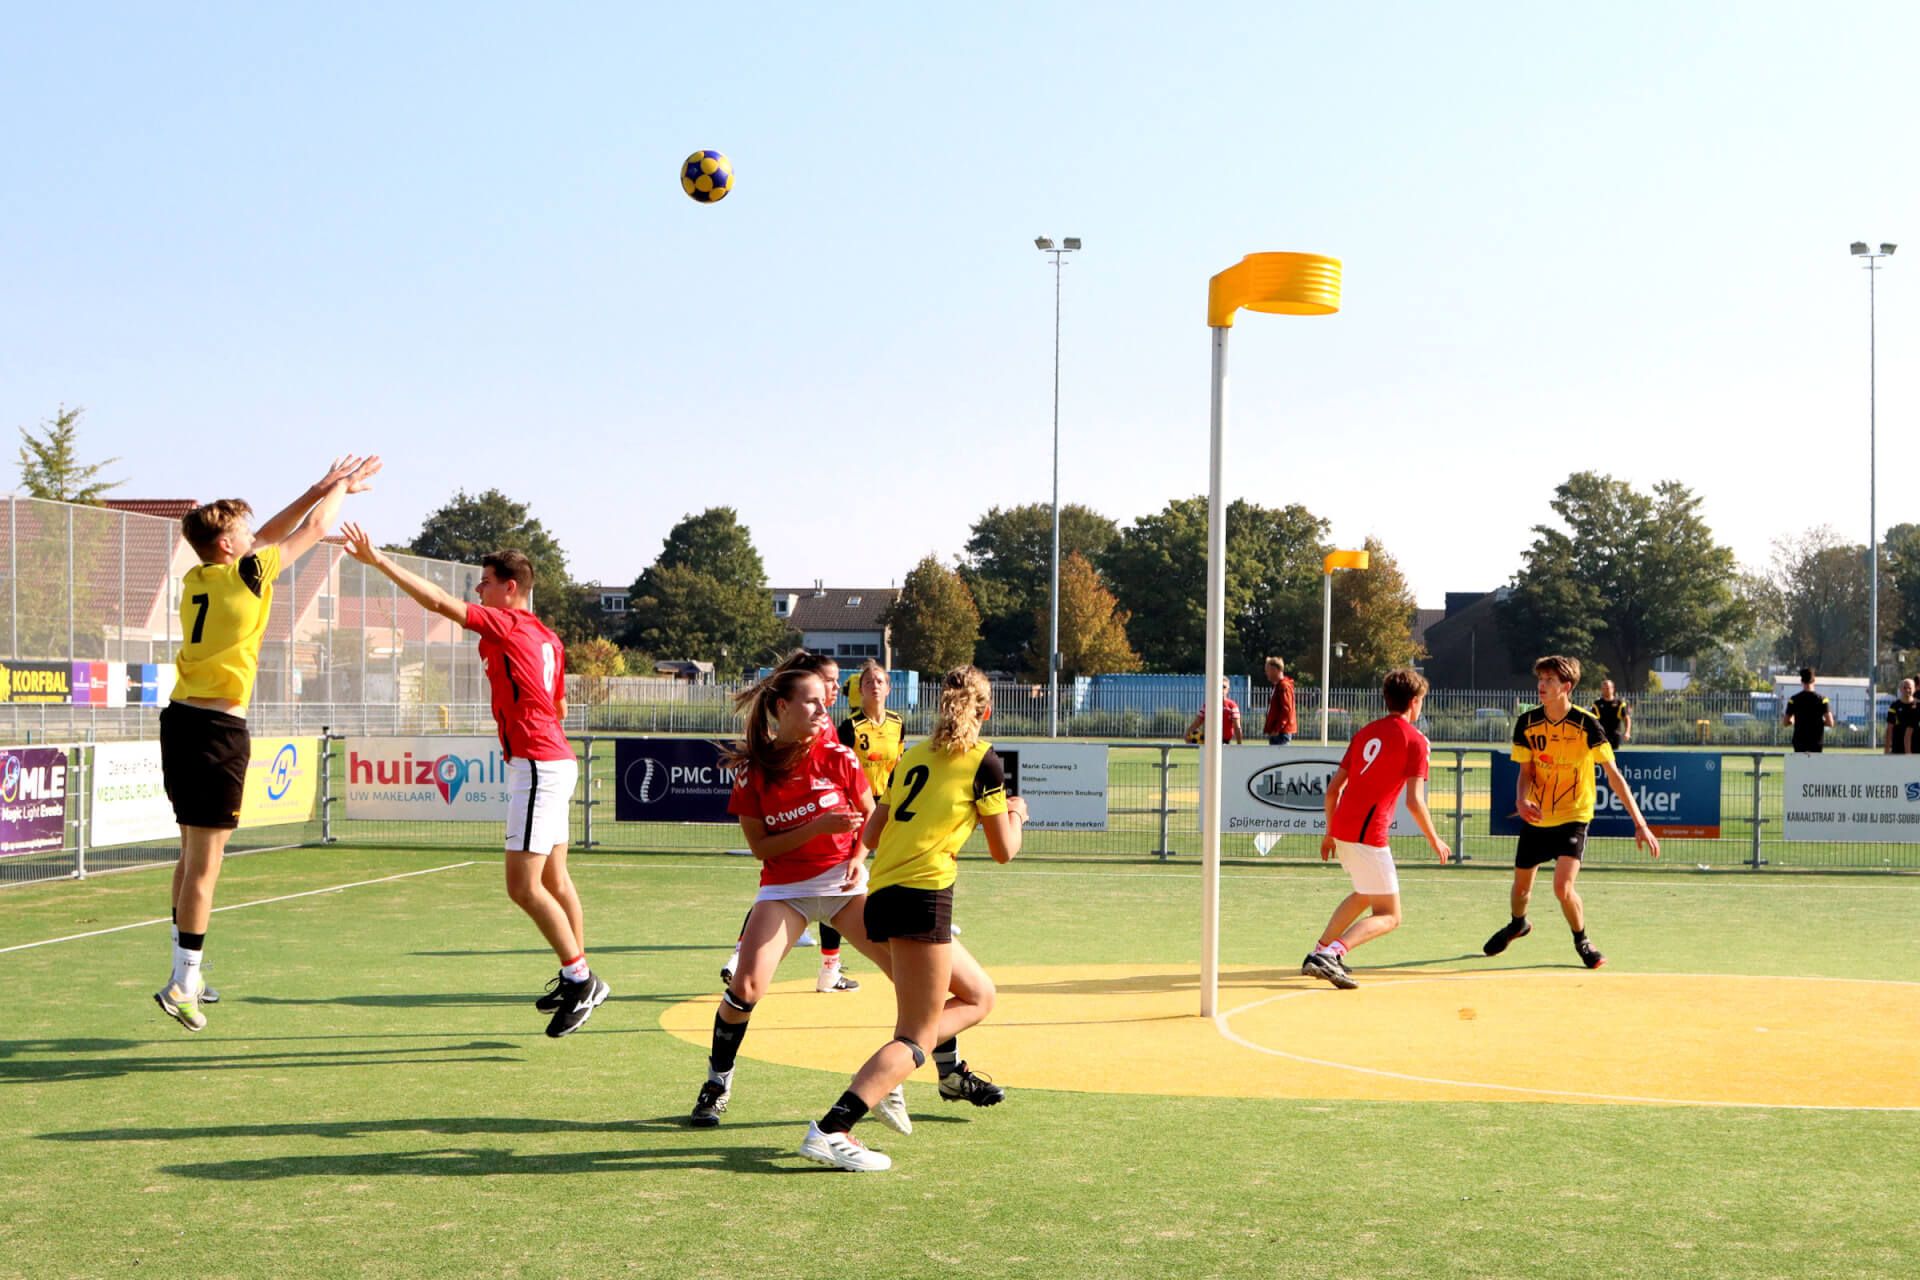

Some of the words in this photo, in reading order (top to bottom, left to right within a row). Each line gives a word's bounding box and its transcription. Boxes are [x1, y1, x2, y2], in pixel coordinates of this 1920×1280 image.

[191, 593, 209, 644] 7
[542, 642, 555, 692] 8
[12, 670, 69, 693] KORFBAL
[860, 733, 869, 750] 3
[1530, 735, 1546, 751] 10
[1360, 738, 1382, 775] 9
[671, 766, 712, 784] PMC
[1041, 763, 1072, 771] Curieweg
[19, 766, 65, 801] MLE
[1265, 773, 1323, 797] JEANS
[1865, 784, 1899, 799] WEERD
[350, 792, 369, 801] UW
[373, 792, 436, 801] MAKELAAR!
[465, 792, 487, 802] 085
[895, 765, 929, 822] 2
[1595, 784, 1681, 812] Deker
[1061, 820, 1074, 828] alle
[1075, 820, 1105, 828] merken!
[1229, 817, 1290, 829] Spijkerhard
[1293, 817, 1306, 828] de
[1787, 811, 1835, 823] KANAALSTRAAT
